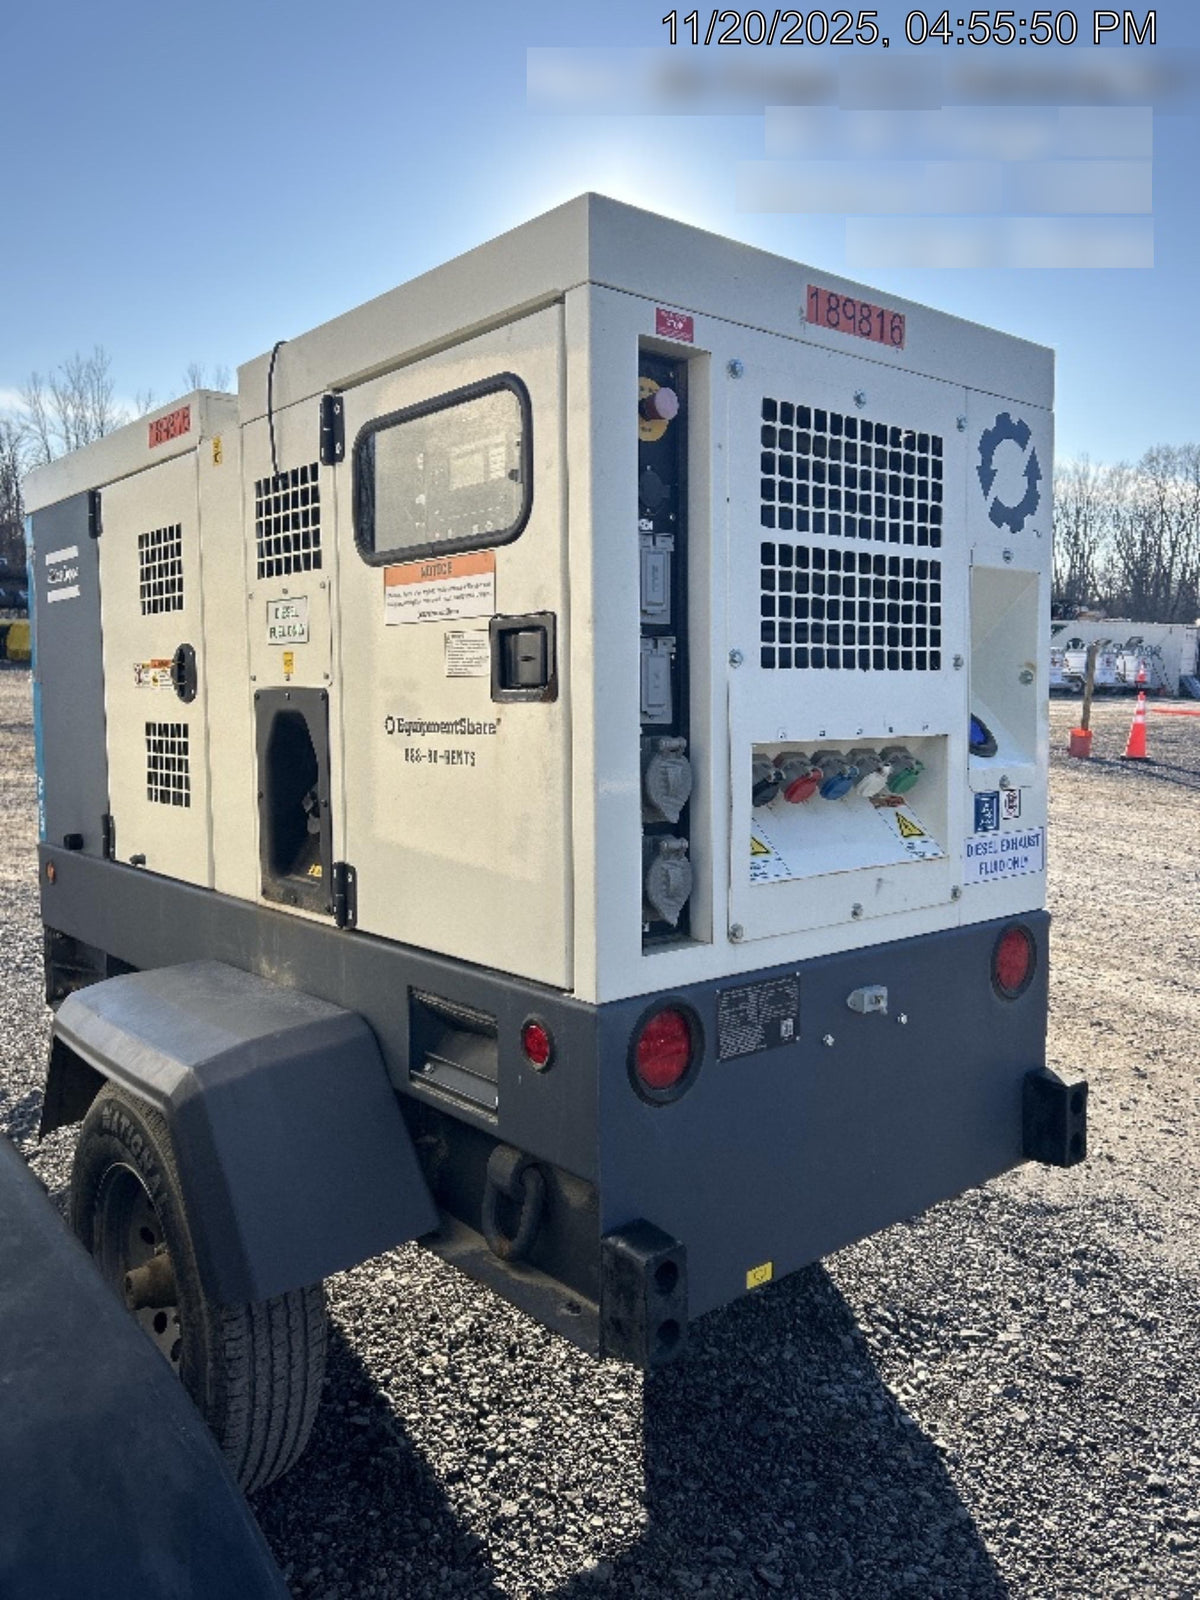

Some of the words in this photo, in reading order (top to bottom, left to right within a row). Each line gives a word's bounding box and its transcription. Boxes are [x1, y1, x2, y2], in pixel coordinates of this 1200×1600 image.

[810, 287, 903, 345] 189816
[421, 562, 452, 578] NOTICE
[966, 841, 998, 858] DIESEL
[1000, 833, 1041, 853] EXHAUST
